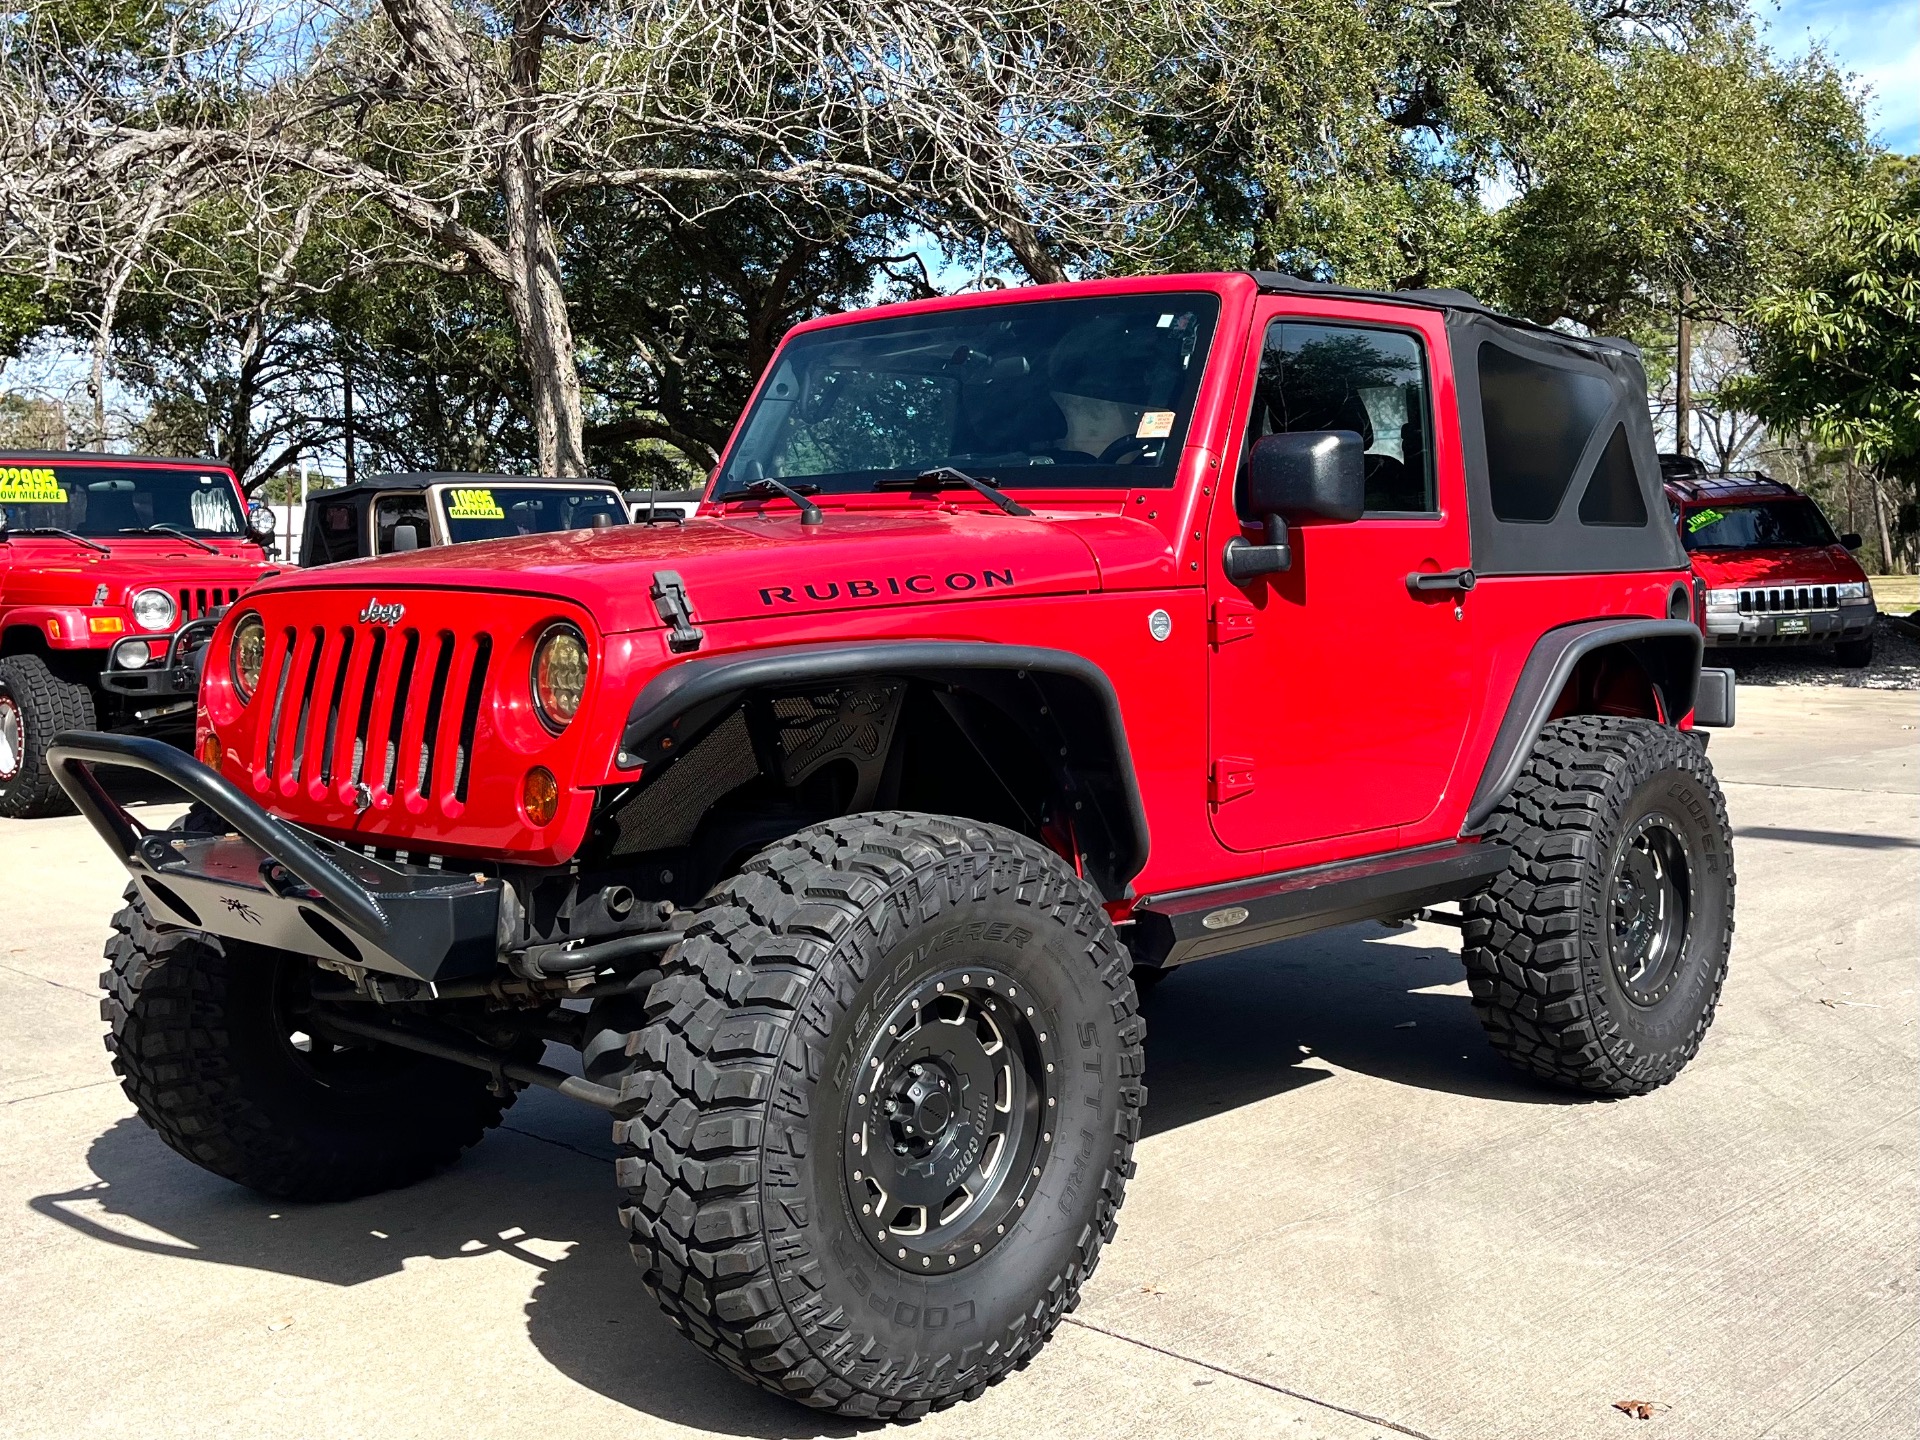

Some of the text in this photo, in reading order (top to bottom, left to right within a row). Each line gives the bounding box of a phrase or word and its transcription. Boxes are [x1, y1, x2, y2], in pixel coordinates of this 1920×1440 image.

[0, 467, 58, 490] 22995
[0, 491, 61, 500] OW MILEAGE
[450, 489, 496, 508] 10995
[451, 508, 502, 516] MANUAL
[758, 568, 1015, 606] RUBICON
[359, 597, 405, 627] Jeep
[1667, 783, 1720, 874] COOPER
[833, 921, 1034, 1091] DISCOVERER
[1058, 1021, 1104, 1217] STT PRO
[945, 1136, 980, 1187] COMP
[831, 1238, 976, 1331] COOPER
